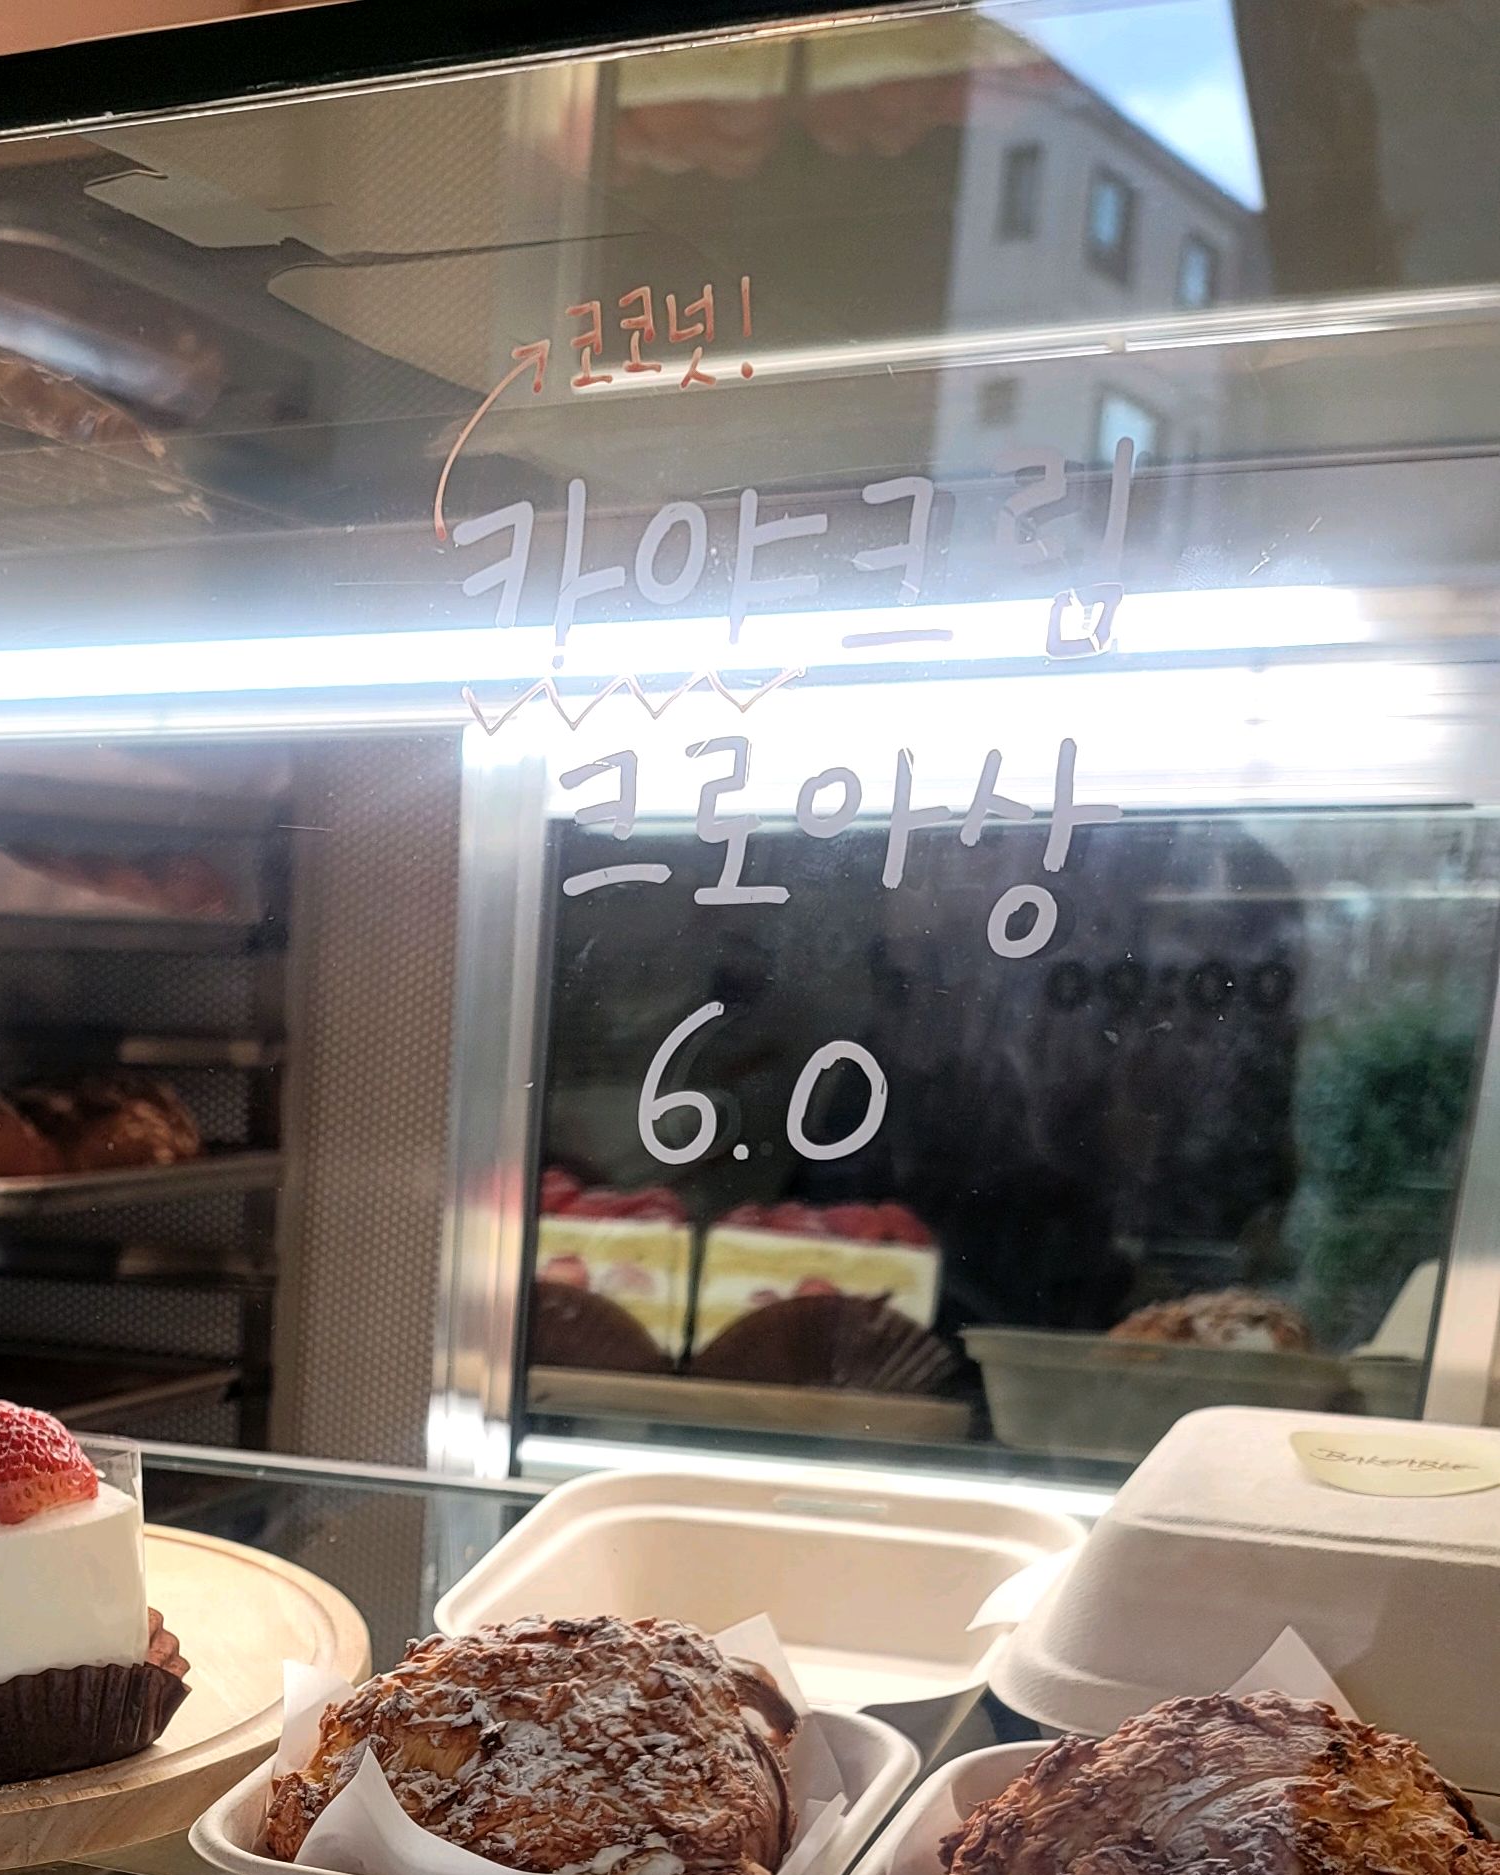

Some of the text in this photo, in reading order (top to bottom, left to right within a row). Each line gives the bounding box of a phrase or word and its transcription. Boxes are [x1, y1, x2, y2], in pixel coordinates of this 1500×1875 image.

[564, 275, 755, 389] 코코넛!
[559, 736, 1124, 959] 크로아상
[637, 1000, 889, 1166] 6.0
